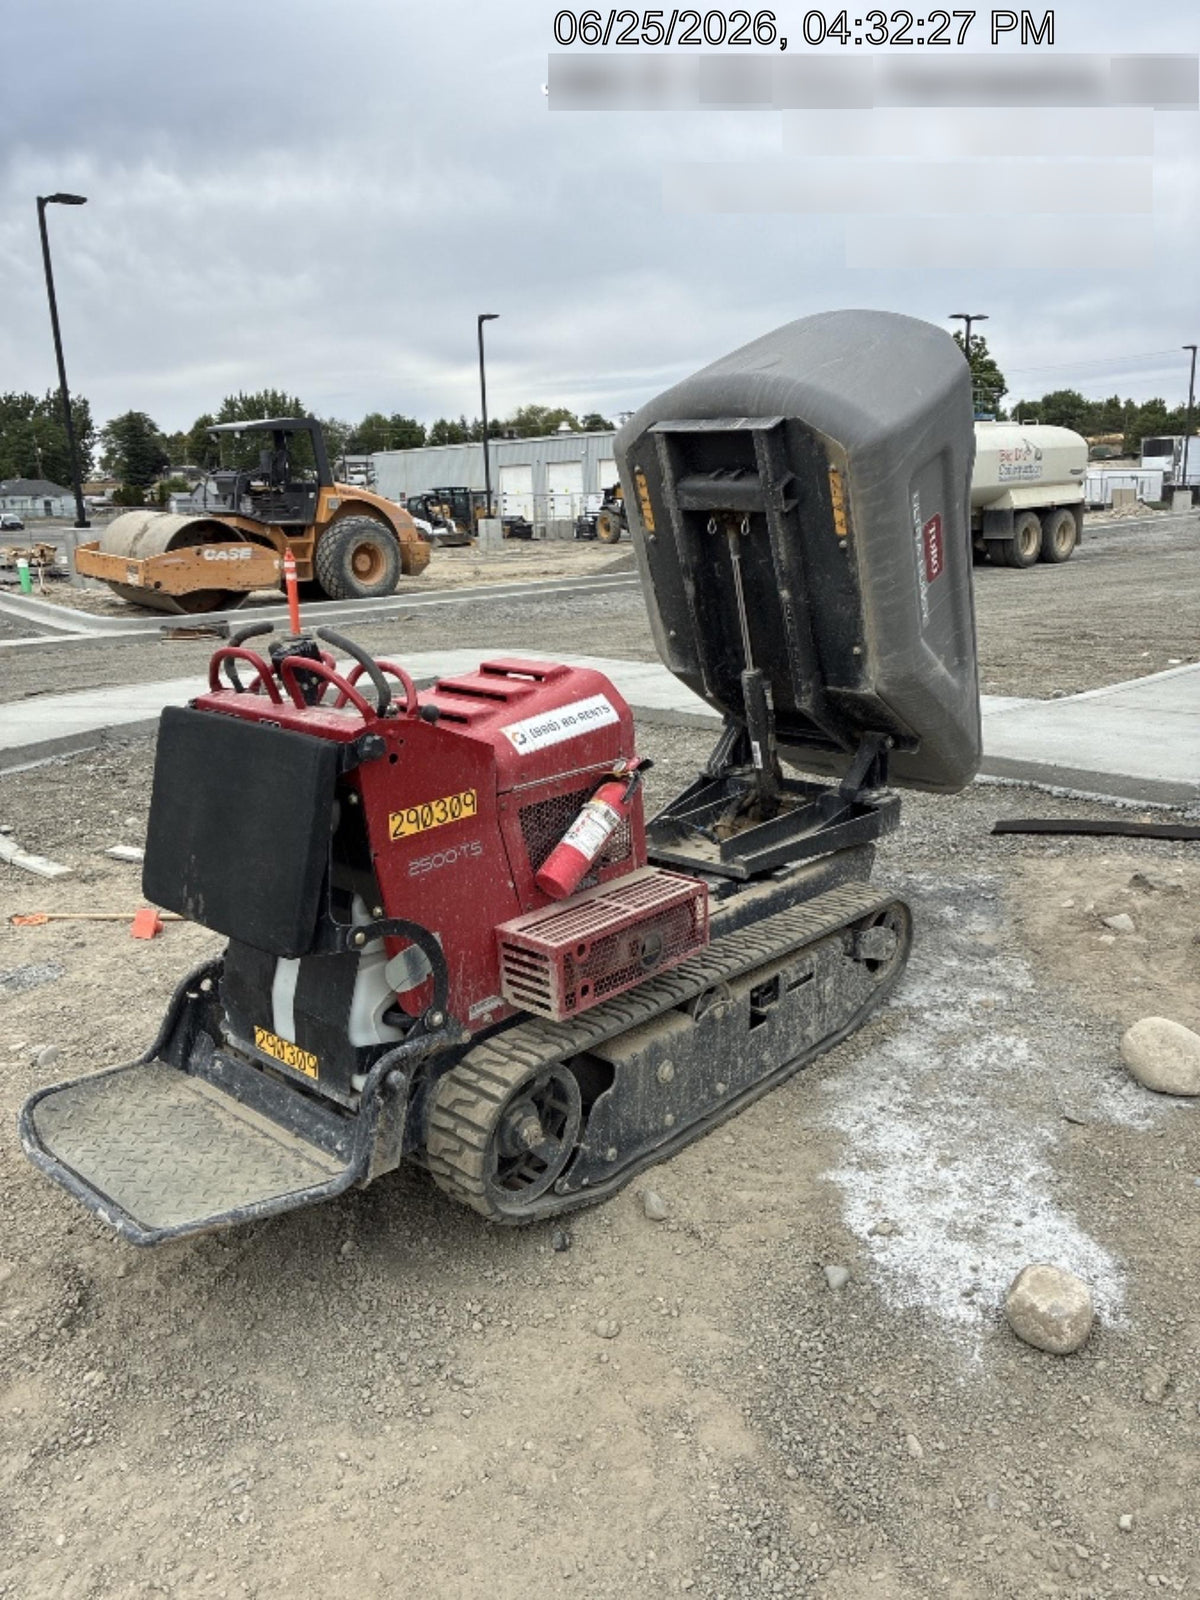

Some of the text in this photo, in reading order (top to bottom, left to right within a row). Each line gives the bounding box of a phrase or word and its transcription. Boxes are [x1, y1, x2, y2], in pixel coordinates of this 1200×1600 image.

[203, 547, 252, 561] CASE
[391, 791, 476, 838] 290309
[256, 1028, 318, 1078] 290309
